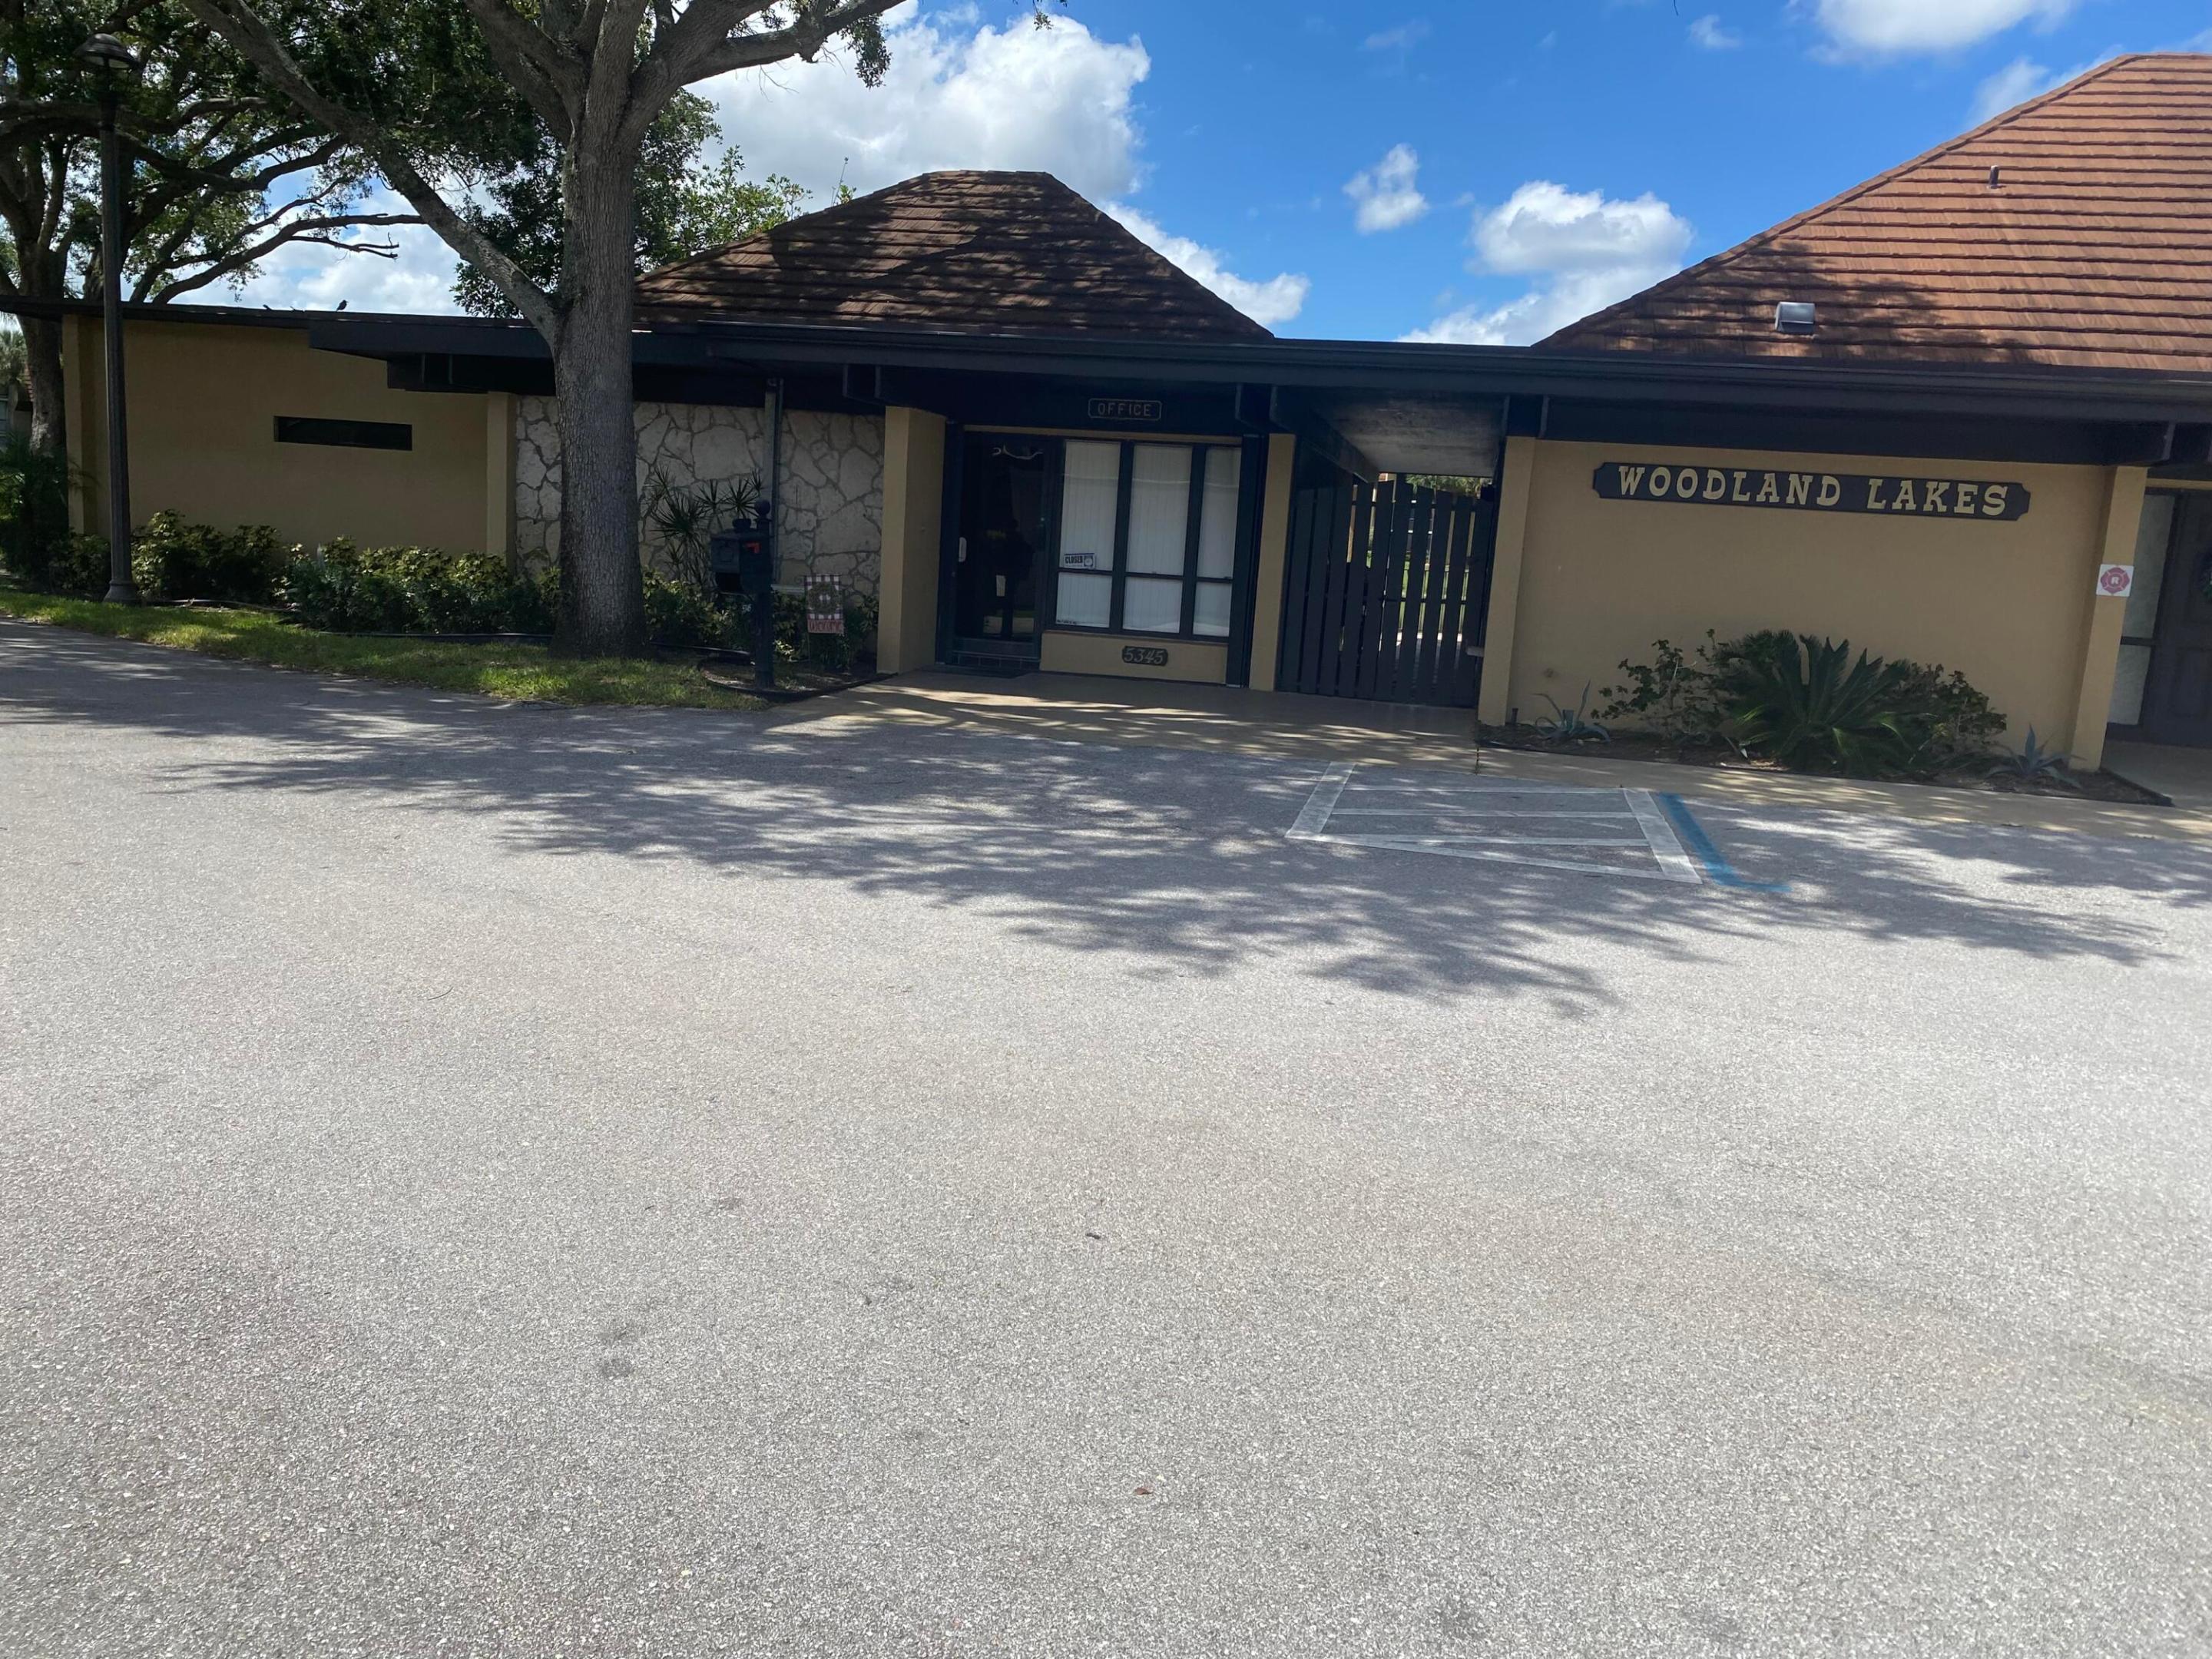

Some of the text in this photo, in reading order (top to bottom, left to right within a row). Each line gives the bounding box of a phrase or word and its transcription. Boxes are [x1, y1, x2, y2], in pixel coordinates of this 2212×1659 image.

[1098, 402, 1152, 416] OFFICE
[1618, 465, 2008, 515] WOODLAND LAKES
[2111, 576, 2120, 584] R
[1124, 647, 1164, 664] 5345
